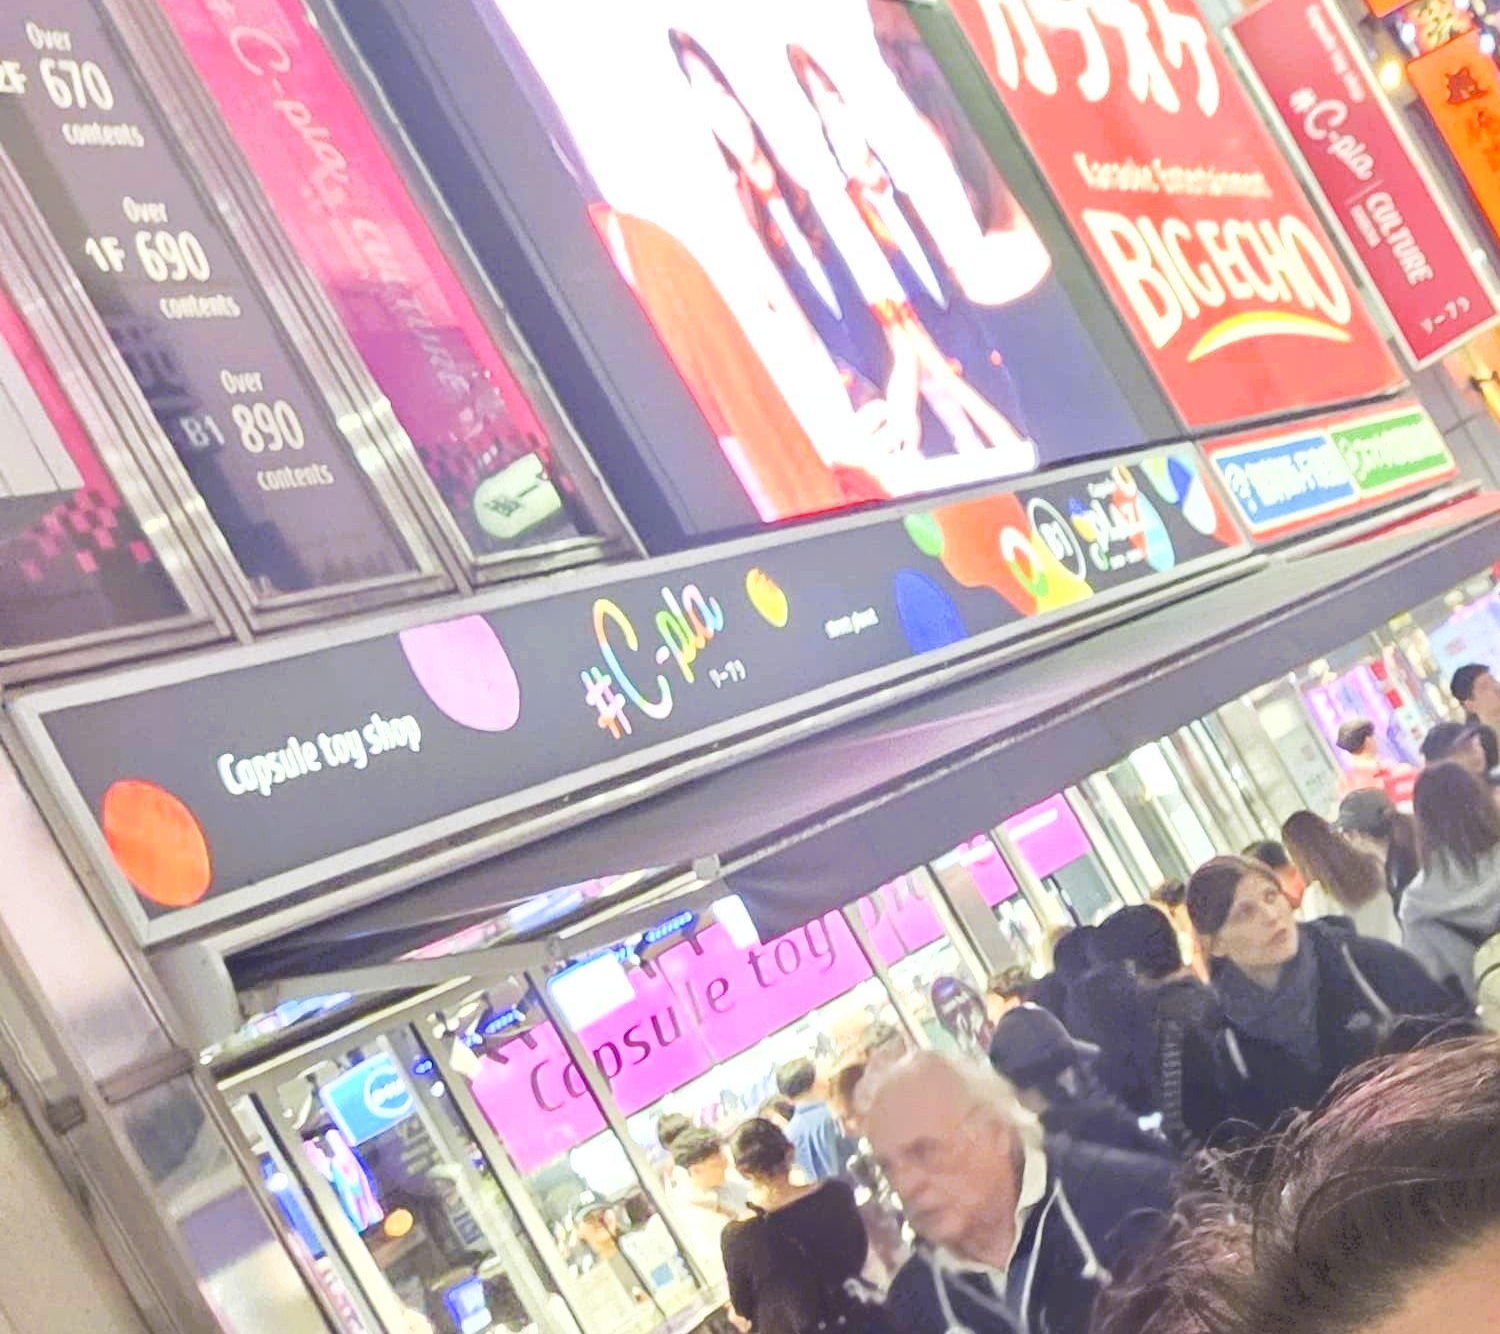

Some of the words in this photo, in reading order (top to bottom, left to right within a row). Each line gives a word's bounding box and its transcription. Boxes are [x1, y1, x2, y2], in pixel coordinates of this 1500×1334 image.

[25, 21, 72, 52] Over
[39, 57, 114, 111] 670
[62, 122, 145, 148] contents
[122, 196, 168, 224] Over
[85, 235, 127, 273] 1F
[135, 229, 211, 283] 690
[1365, 191, 1434, 287] CULTURE
[1082, 209, 1228, 350] BIG
[1193, 214, 1353, 327] ECHO
[159, 294, 242, 320] contents
[219, 369, 264, 395] Over
[231, 399, 306, 454] 890
[256, 463, 336, 492] contents
[216, 736, 323, 797] Capsule
[316, 732, 369, 770] toy
[362, 712, 422, 755] shop
